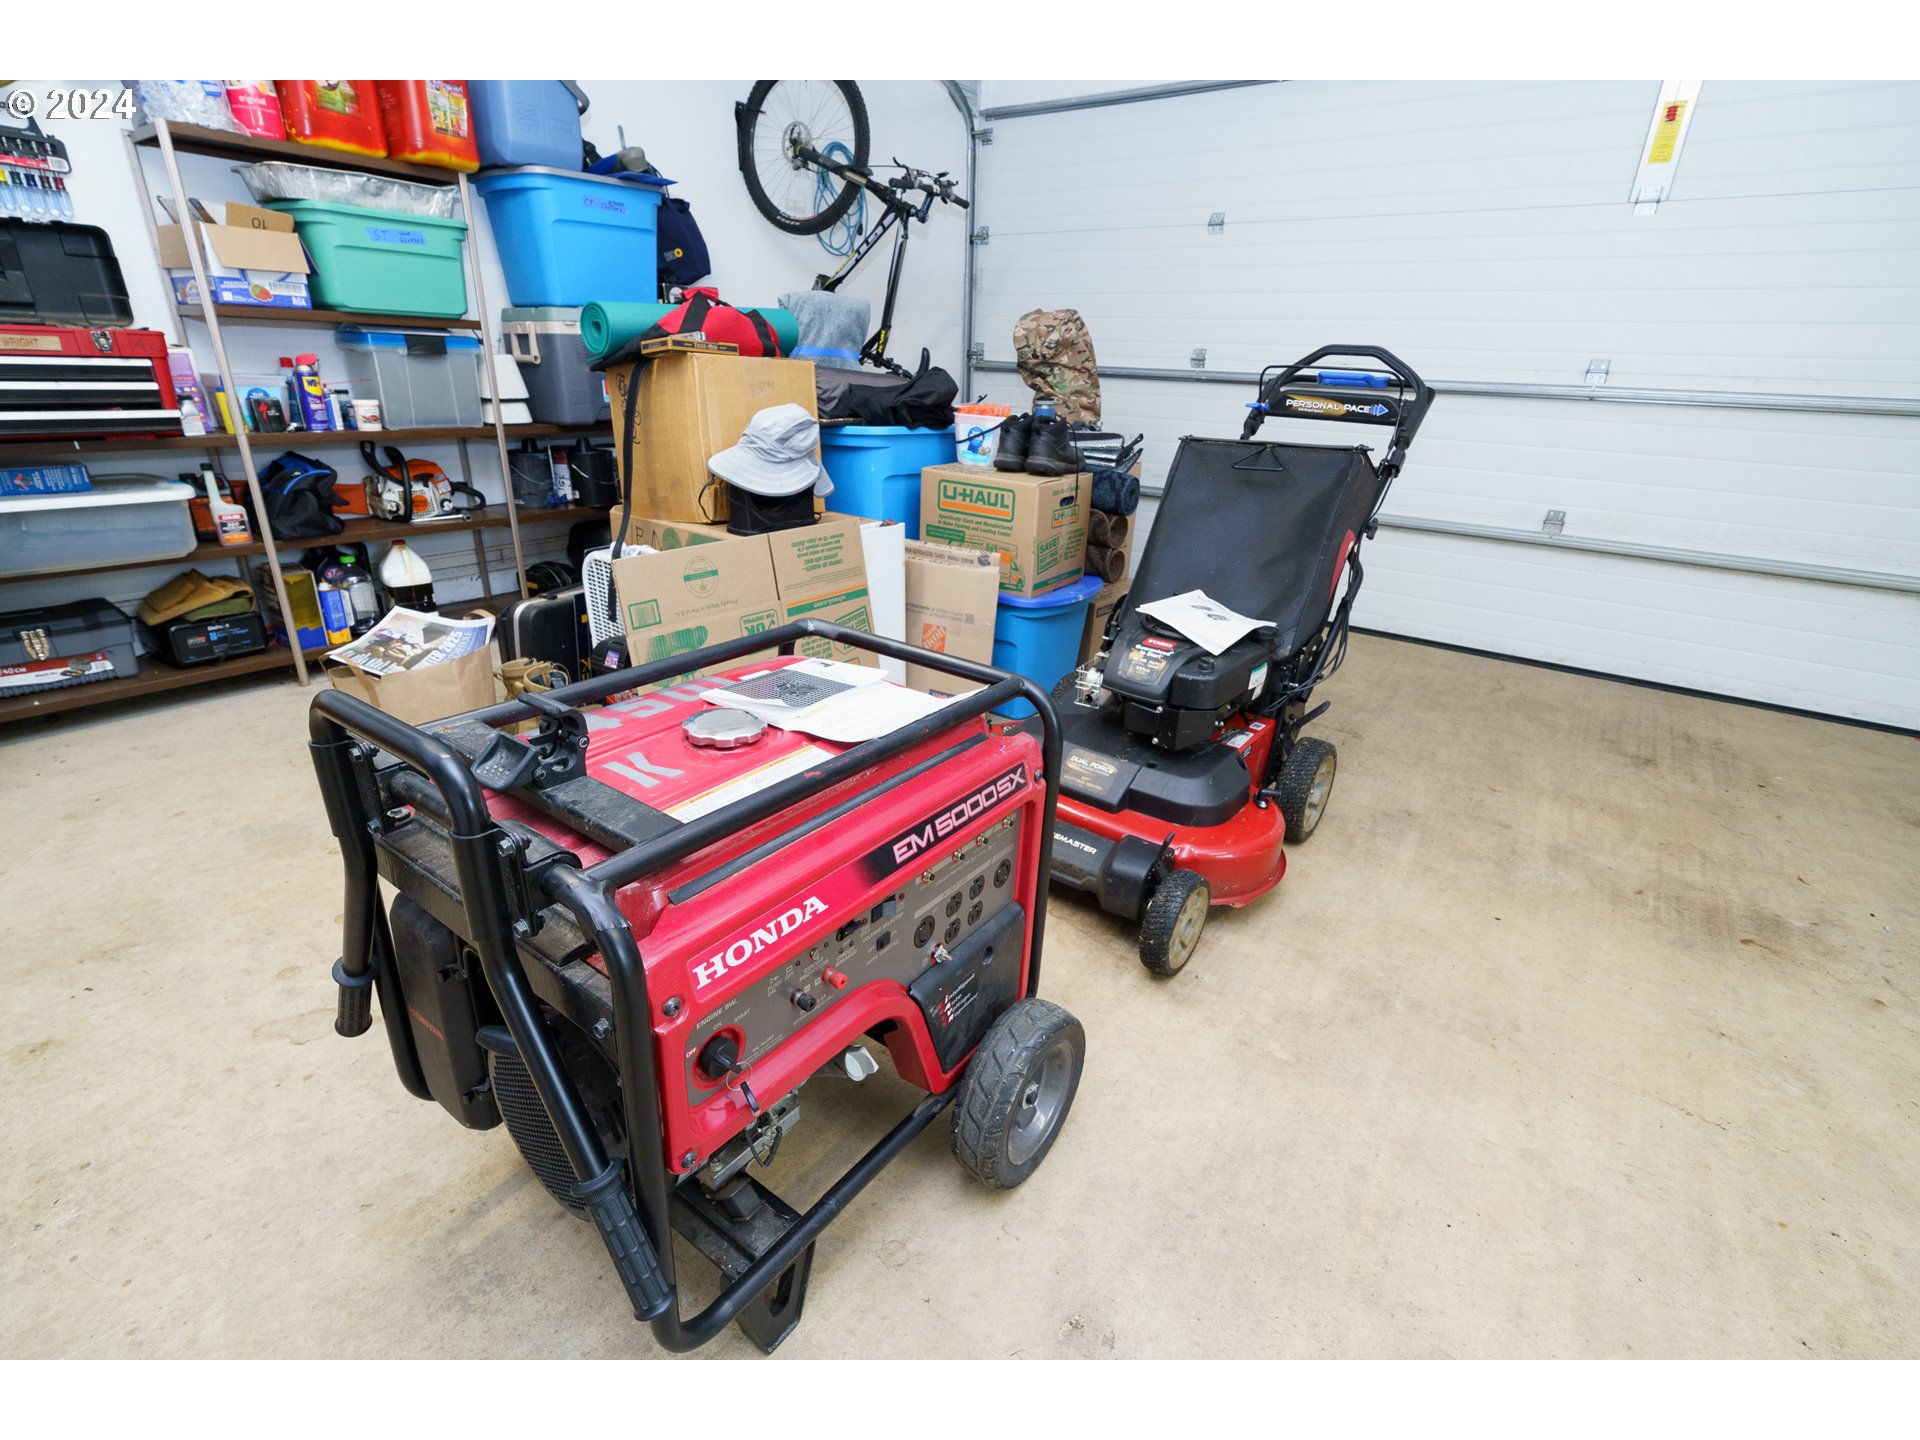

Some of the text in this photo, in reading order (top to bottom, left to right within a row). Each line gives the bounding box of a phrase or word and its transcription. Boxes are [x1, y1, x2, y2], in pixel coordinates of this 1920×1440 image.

[1286, 399, 1371, 414] PERSONAL PACE
[943, 485, 1009, 509] U-HAUL
[1135, 644, 1174, 656] Guaranteed
[1147, 638, 1174, 649] TORO
[1070, 755, 1114, 775] DUAL FORCE
[692, 895, 829, 990] HONDA
[696, 1009, 722, 1030] ENGINE
[734, 1009, 750, 1022] START
[713, 1021, 722, 1030] ON
[686, 1047, 697, 1058] OFF
